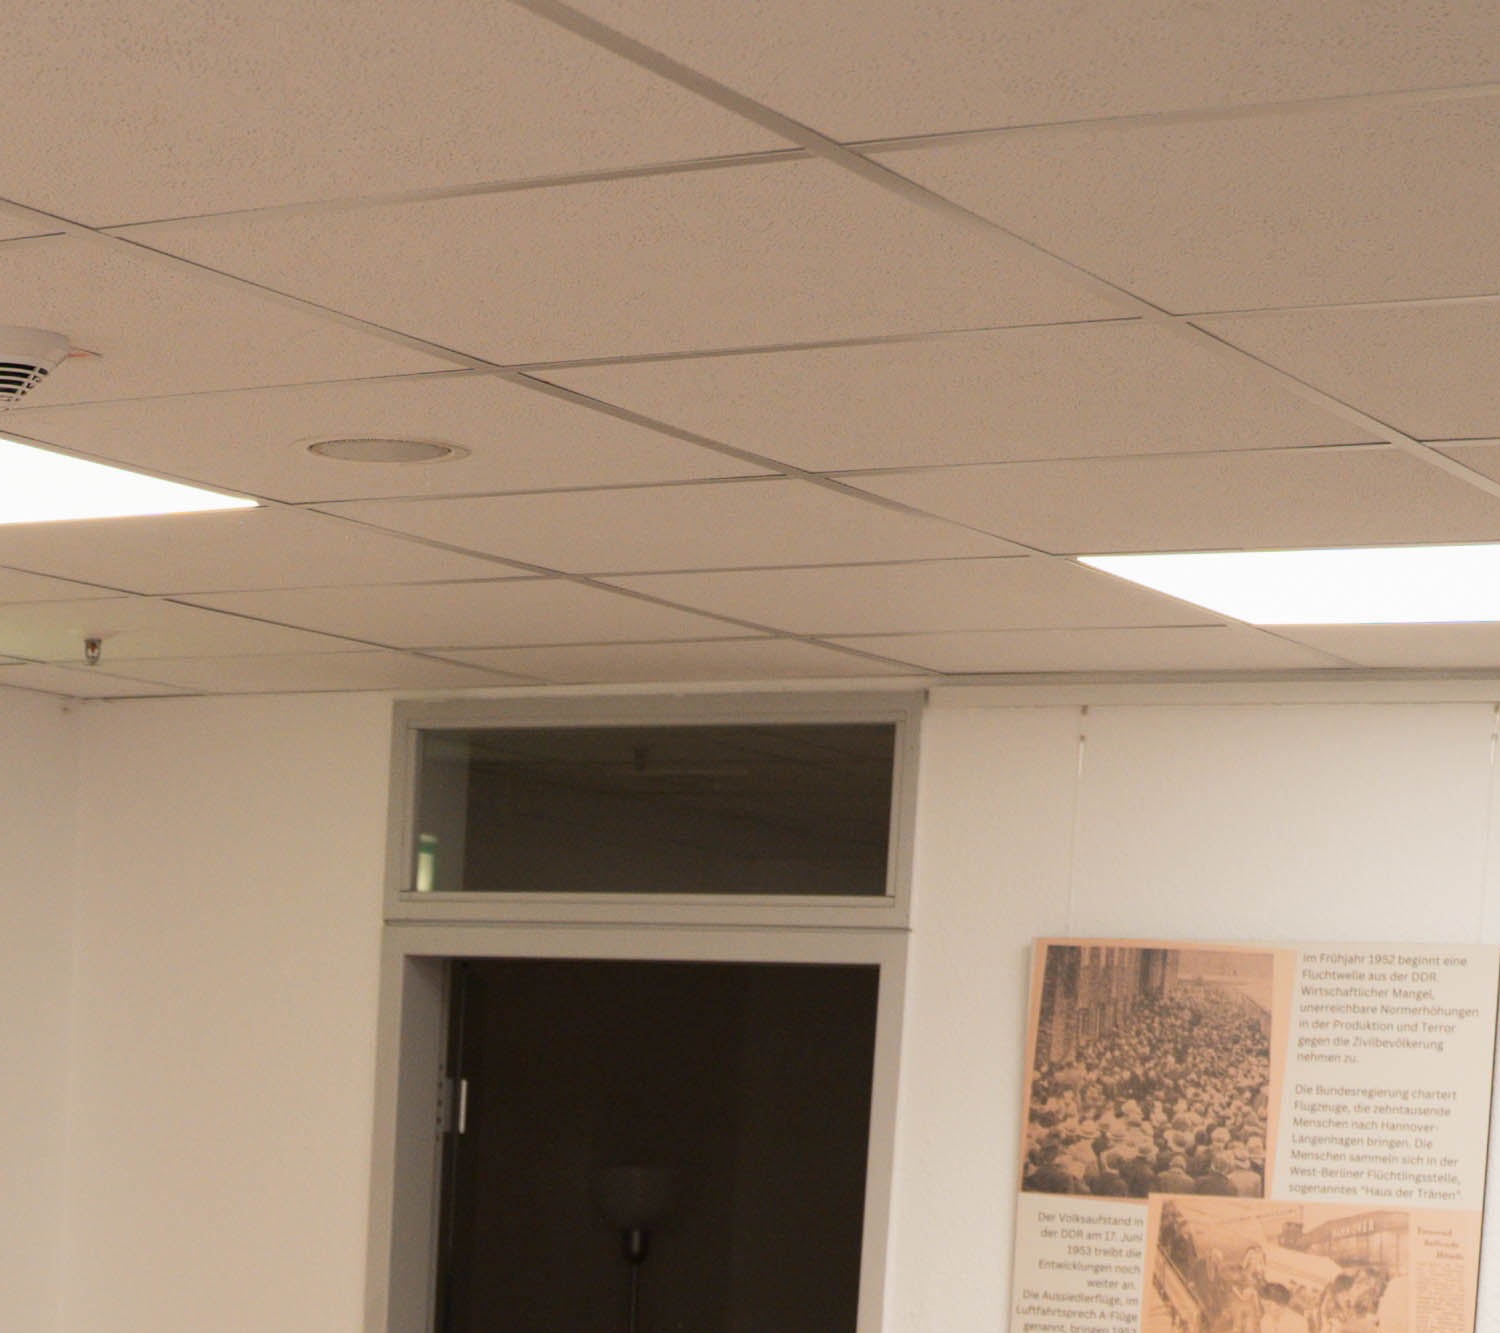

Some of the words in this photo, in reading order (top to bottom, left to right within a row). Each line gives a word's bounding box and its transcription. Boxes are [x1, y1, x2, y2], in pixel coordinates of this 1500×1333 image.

[1319, 952, 1365, 966] Frühjahr
[1397, 954, 1440, 968] beginnt
[1442, 957, 1467, 966] eine
